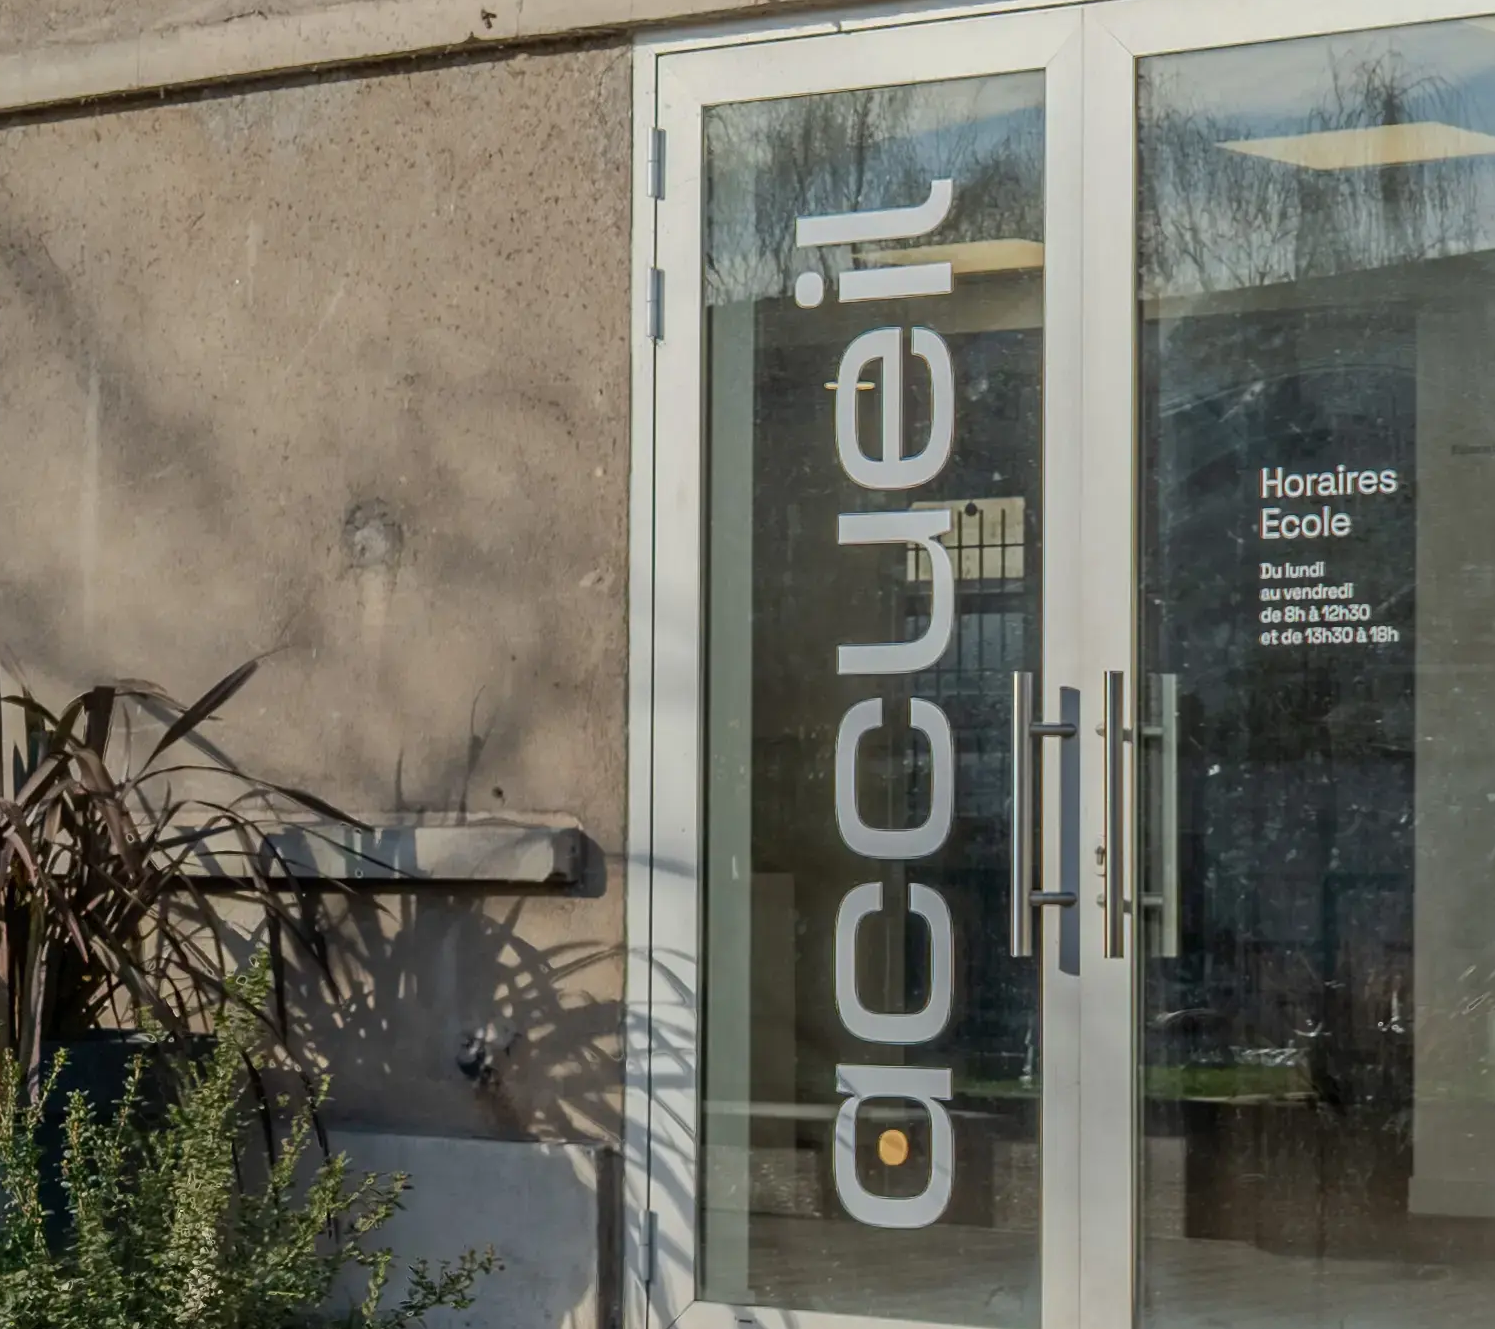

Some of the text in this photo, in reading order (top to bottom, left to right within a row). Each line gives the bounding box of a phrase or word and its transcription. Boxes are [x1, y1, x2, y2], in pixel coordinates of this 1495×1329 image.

[1260, 464, 1398, 499] Horaires
[1260, 505, 1352, 540] Ecole
[1260, 561, 1325, 579] Du lundi
[1259, 583, 1354, 601] au vendredi
[1259, 603, 1371, 624] de 8h à 12h30
[1260, 626, 1399, 646] et de 13h30 à 18h
[794, 176, 957, 1231] accueil
